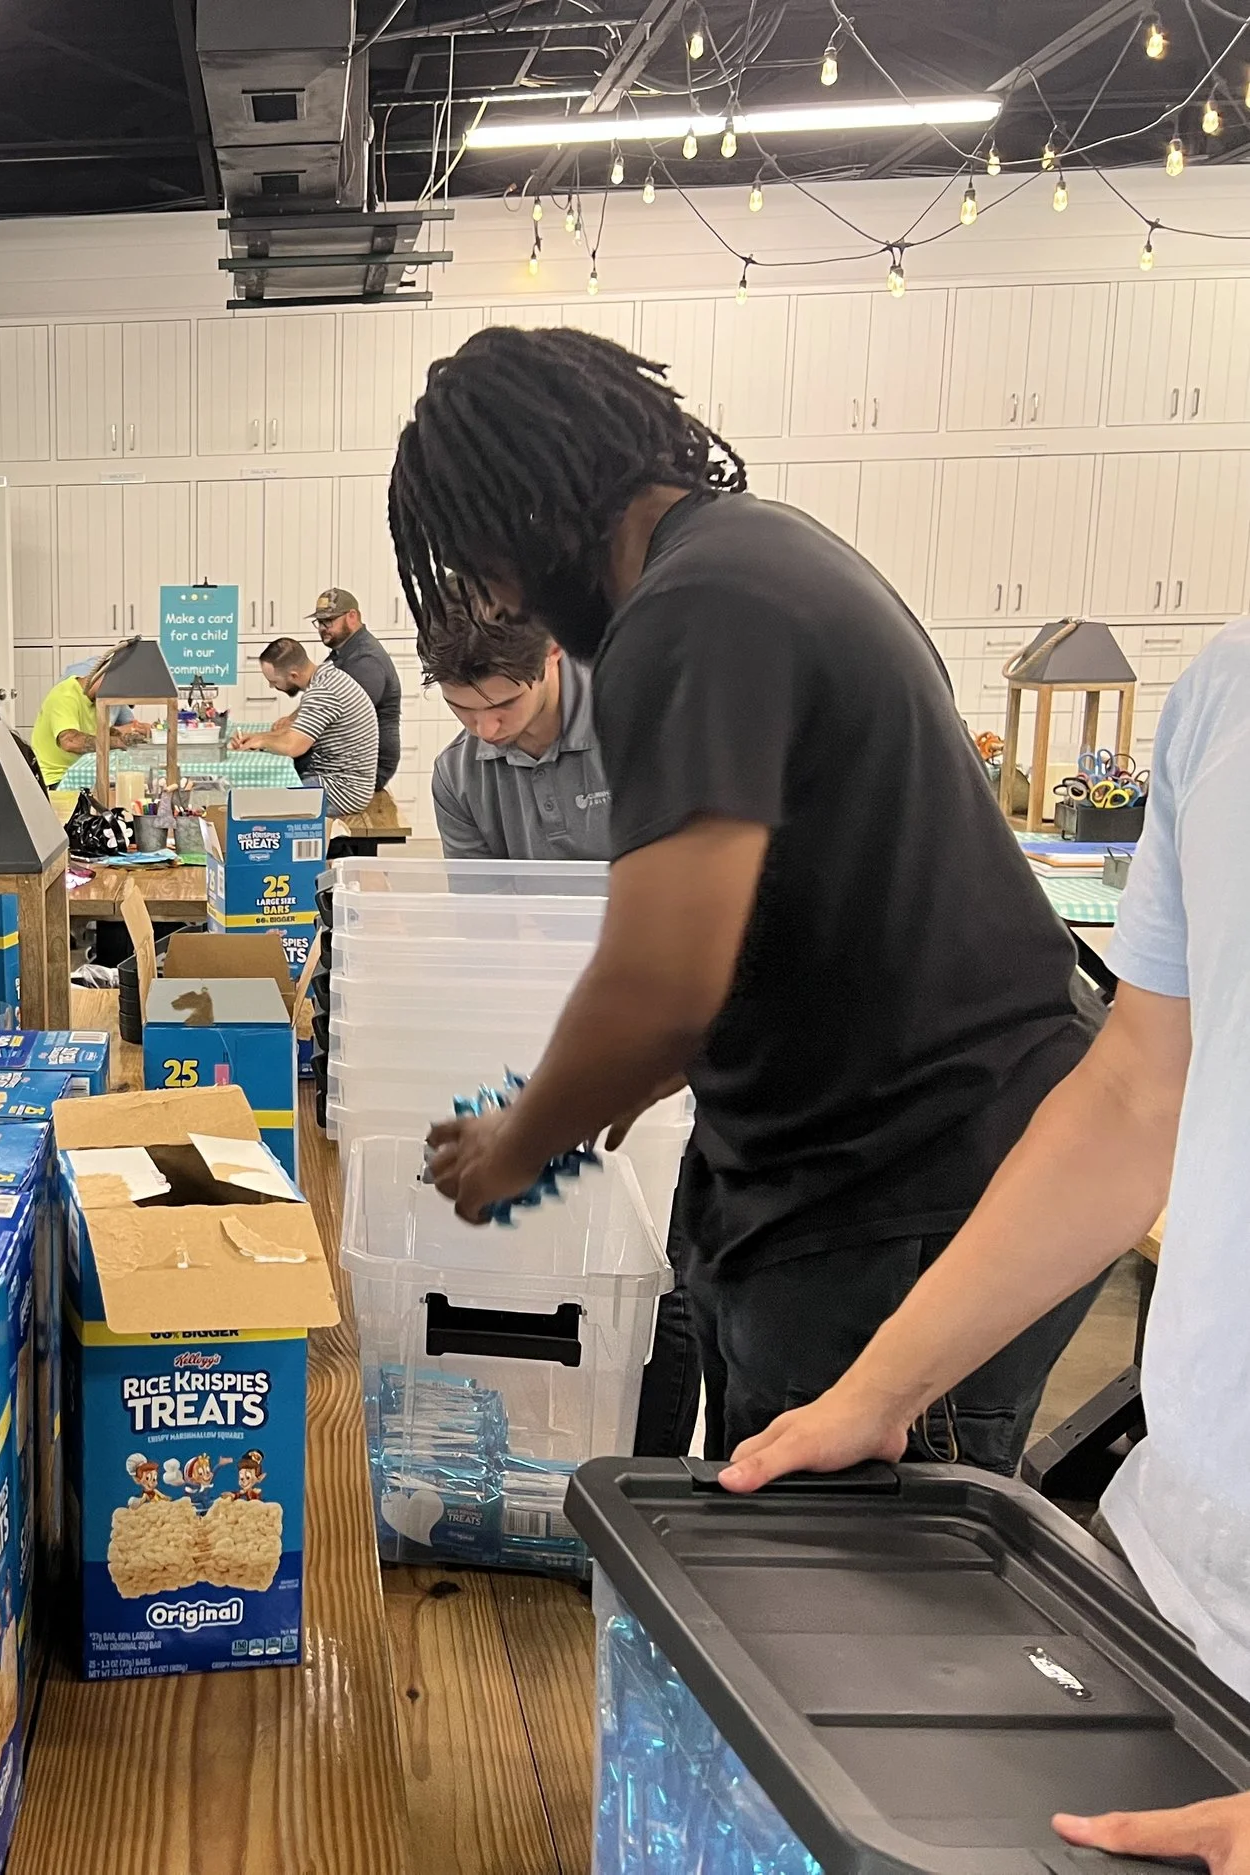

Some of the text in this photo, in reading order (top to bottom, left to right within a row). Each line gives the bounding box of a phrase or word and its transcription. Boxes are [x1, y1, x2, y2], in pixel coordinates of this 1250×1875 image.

[166, 613, 233, 624] Make a card
[170, 629, 228, 641] for a child
[183, 647, 214, 657] in our
[170, 664, 229, 677] community!
[239, 839, 280, 850] TREATS
[263, 875, 290, 898] 25
[257, 898, 279, 906] LARGE
[263, 905, 290, 915] BARS
[163, 1059, 198, 1087] 25
[174, 1352, 222, 1368] Kellogg's
[123, 1371, 269, 1399] RICE KRISPIES
[127, 1393, 266, 1431] TREATS
[148, 1431, 244, 1443] CRISPY MARSHMALLOW SQUARES
[449, 1514, 481, 1526] TREATS
[152, 1603, 237, 1627] Original
